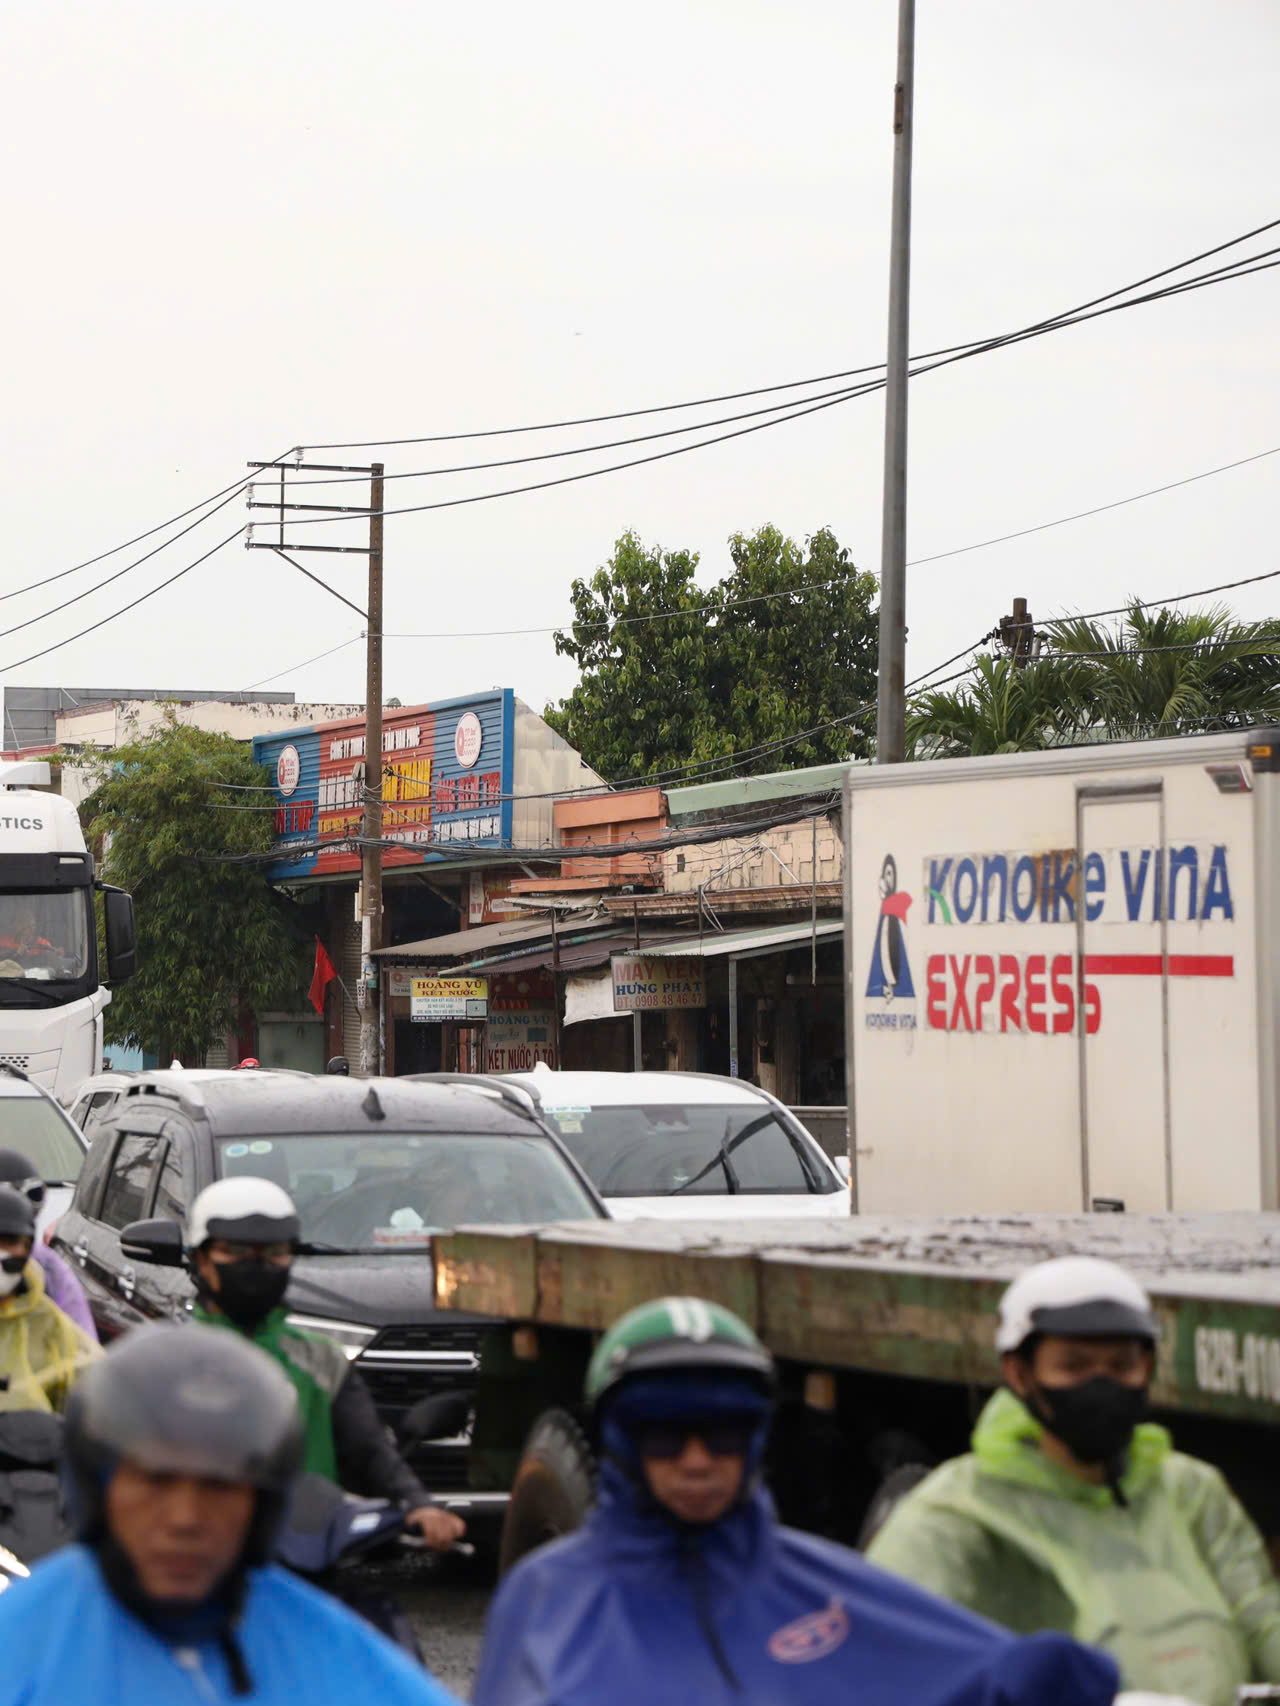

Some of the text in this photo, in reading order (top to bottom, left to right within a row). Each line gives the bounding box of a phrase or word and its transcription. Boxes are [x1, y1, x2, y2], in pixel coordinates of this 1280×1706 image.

[615, 962, 656, 982] MAY
[616, 979, 703, 996] HƯNG PHÁT
[927, 953, 1102, 1035] EXPRESS
[635, 995, 658, 1008] 0908
[508, 1043, 531, 1070] NƯỚC
